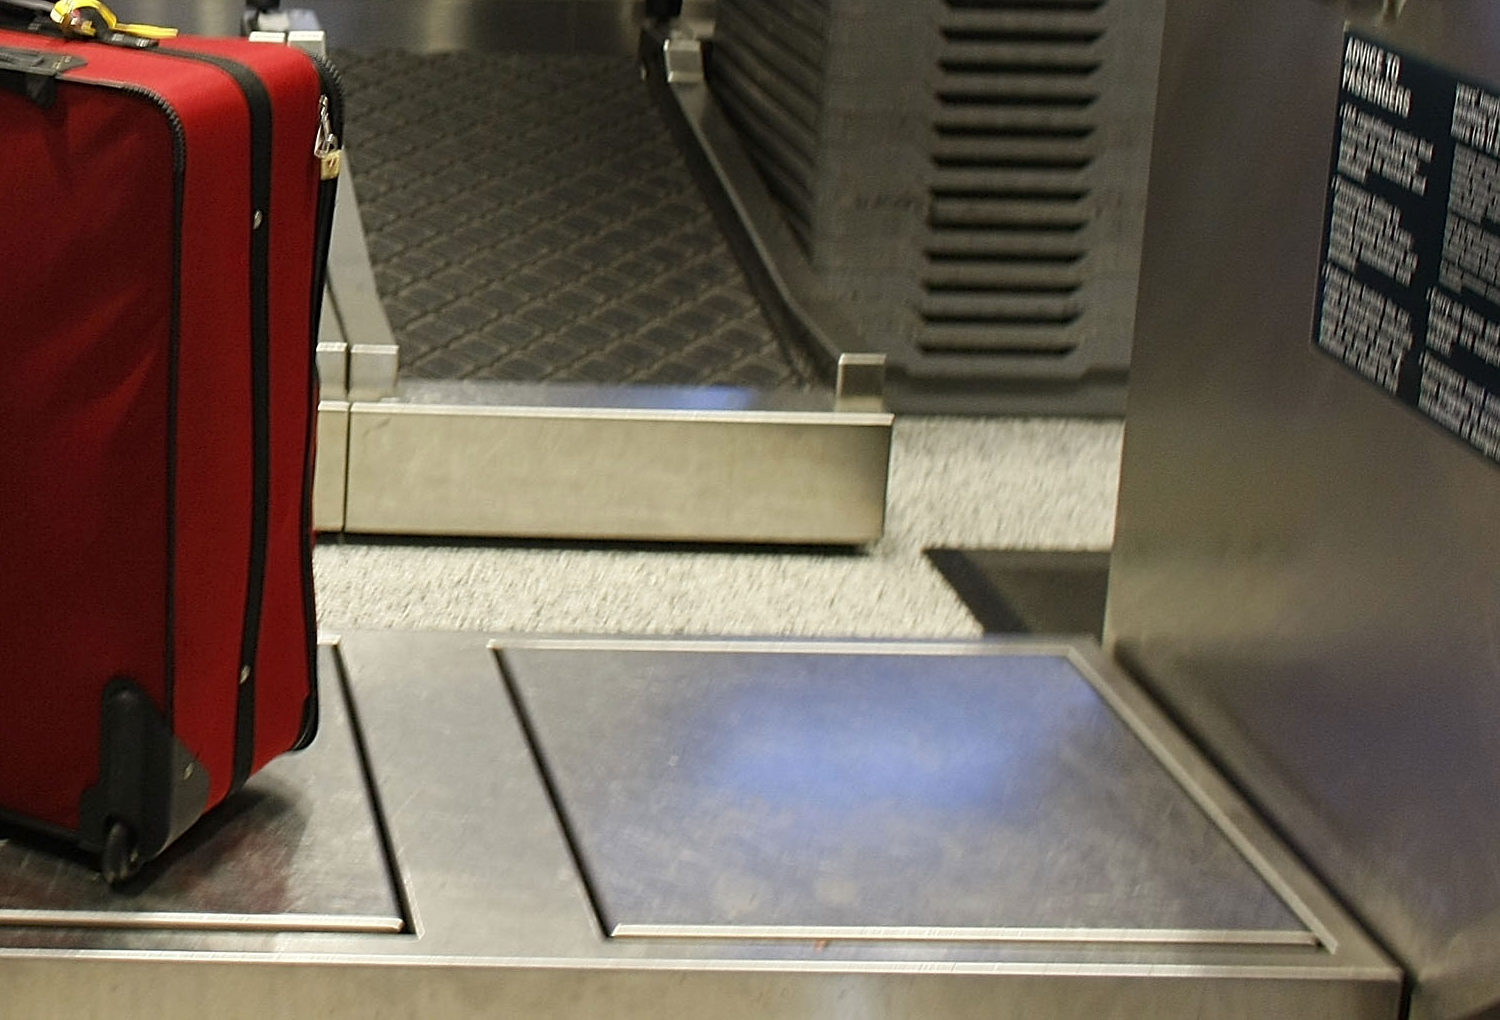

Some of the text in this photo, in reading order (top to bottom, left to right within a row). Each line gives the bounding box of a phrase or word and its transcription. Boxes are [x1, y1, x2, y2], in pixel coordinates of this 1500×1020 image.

[1343, 36, 1400, 83] ADVICE TO
[1341, 63, 1412, 119] PASSENGERS
